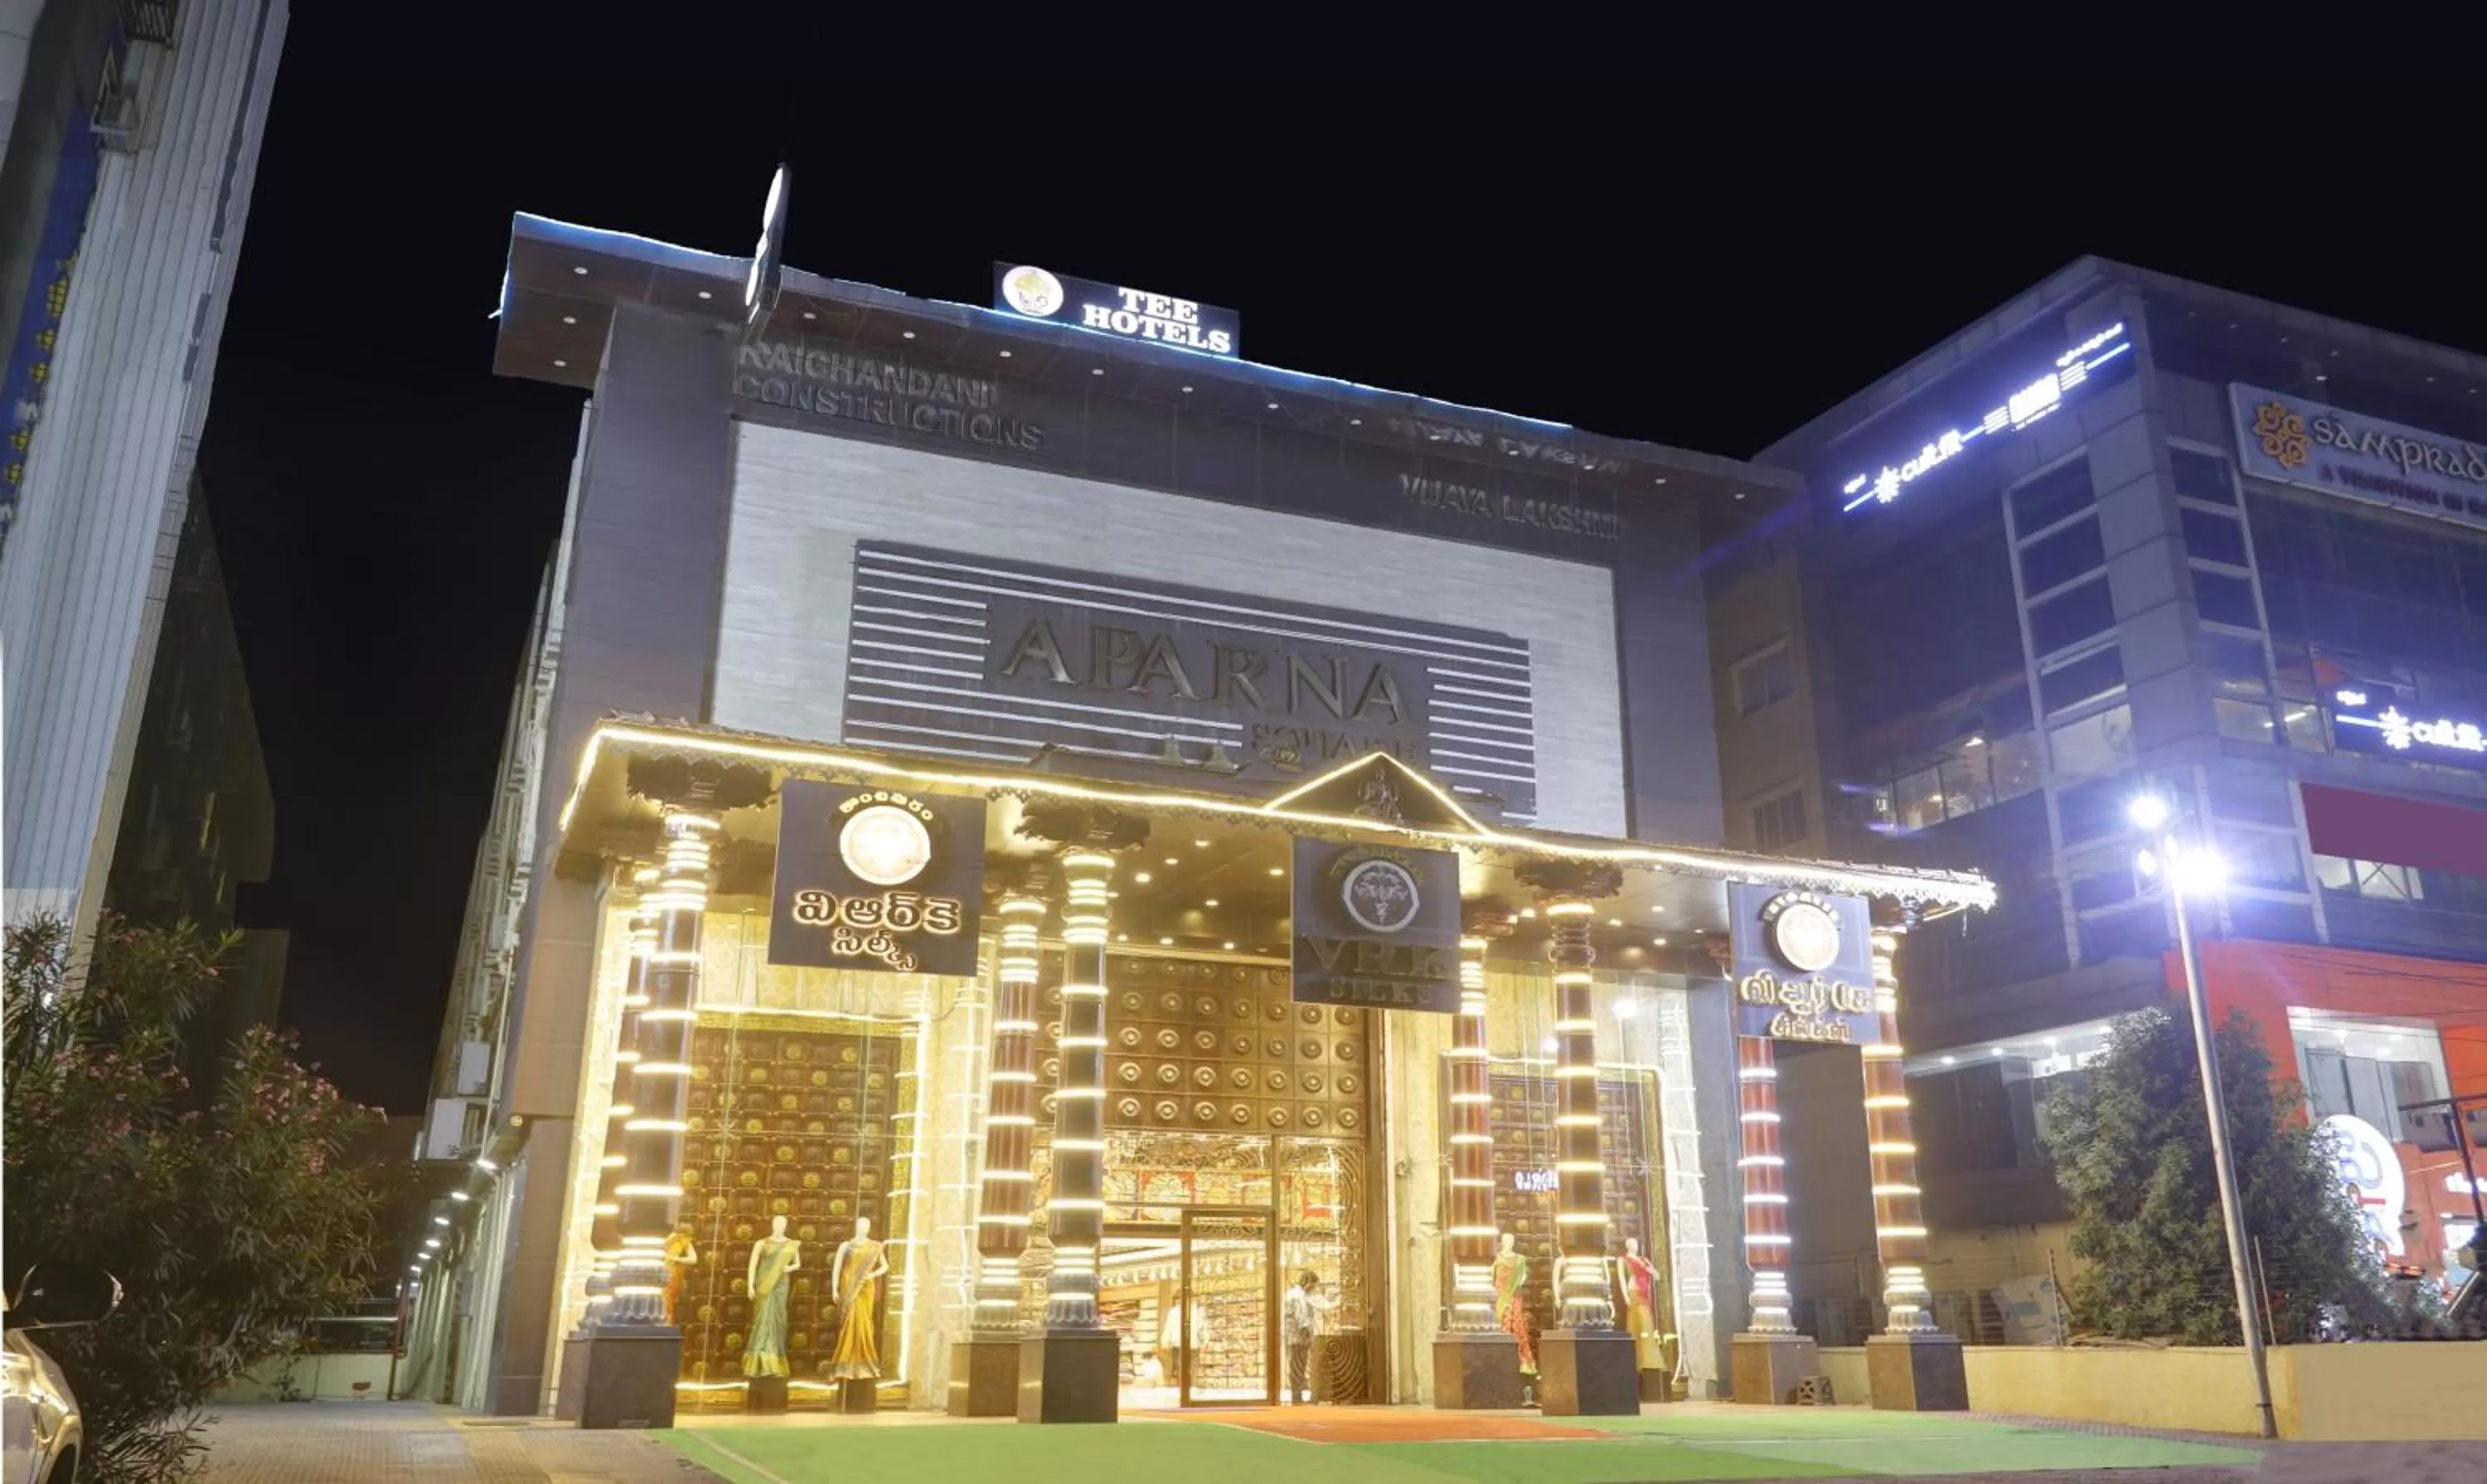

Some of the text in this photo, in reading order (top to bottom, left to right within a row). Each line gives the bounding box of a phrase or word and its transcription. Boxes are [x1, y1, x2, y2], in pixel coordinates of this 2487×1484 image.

[1083, 303, 1231, 353] HOTELS
[1119, 286, 1198, 324] TEE
[1001, 617, 1411, 726] APARNA
